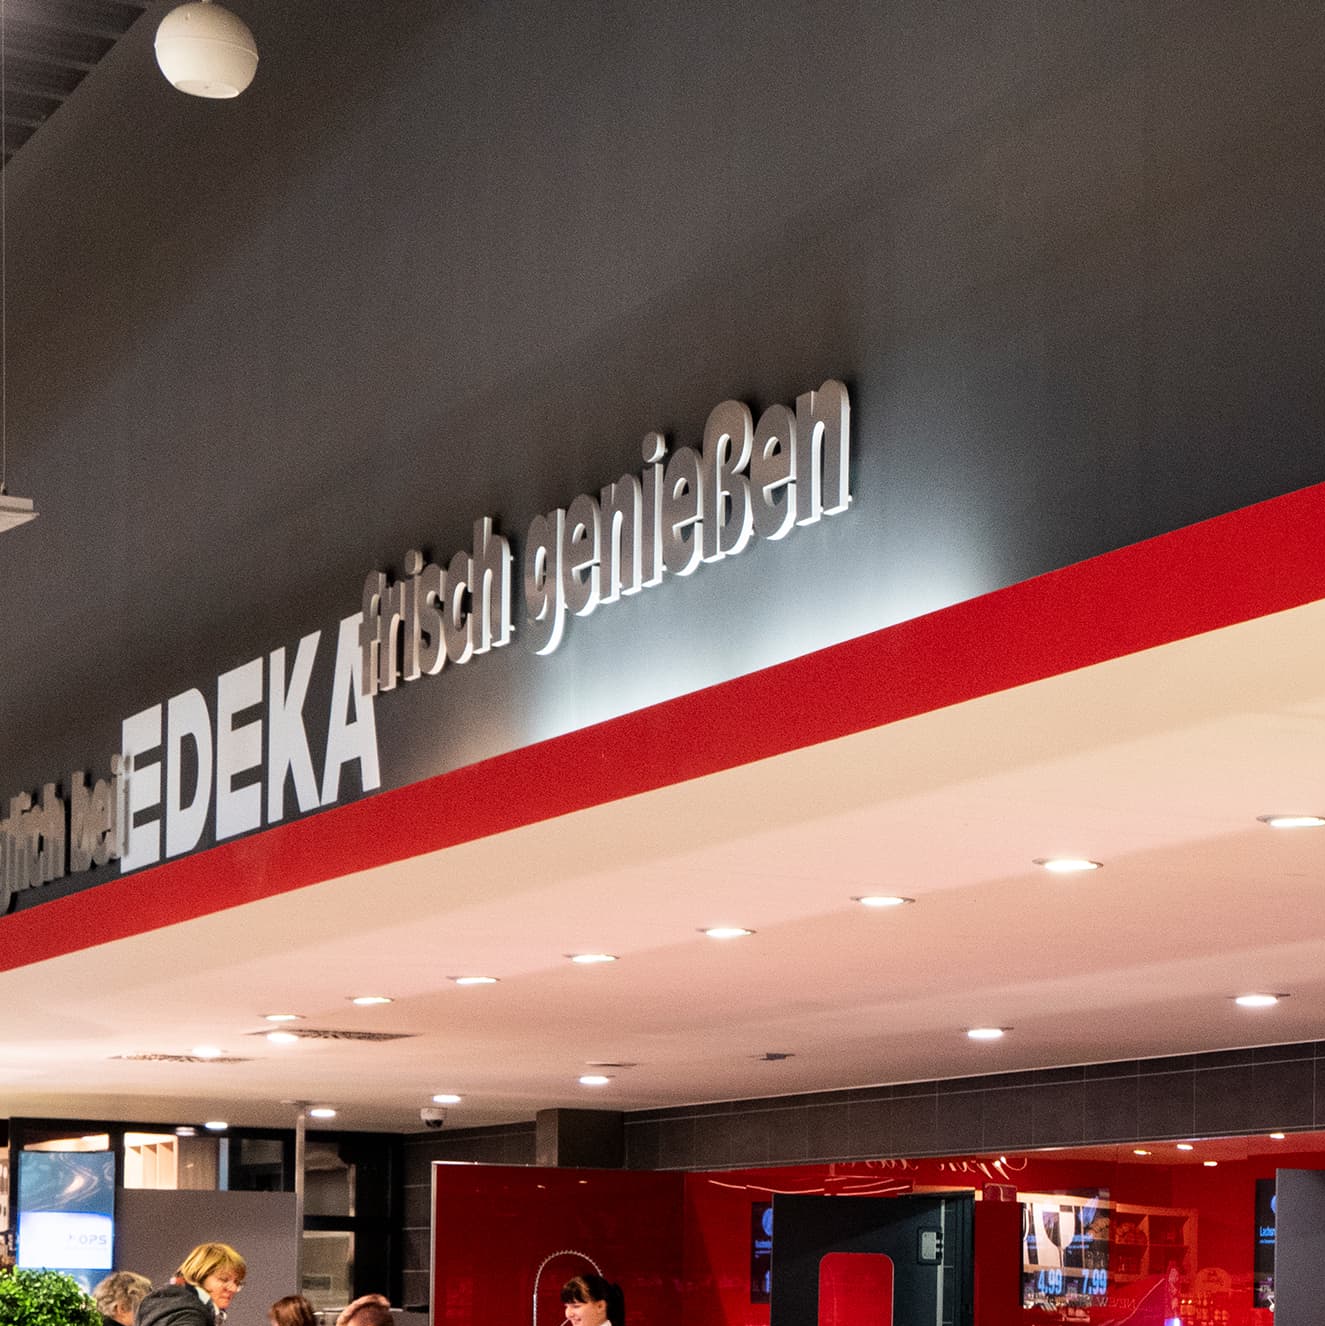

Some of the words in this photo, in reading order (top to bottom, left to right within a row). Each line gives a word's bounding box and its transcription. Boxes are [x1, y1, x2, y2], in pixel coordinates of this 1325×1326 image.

[121, 612, 381, 874] EDEKA
[360, 515, 517, 697] frisch
[525, 378, 854, 656] genießen
[1038, 1268, 1062, 1294] 4.99
[1082, 1268, 1107, 1295] 7.99
